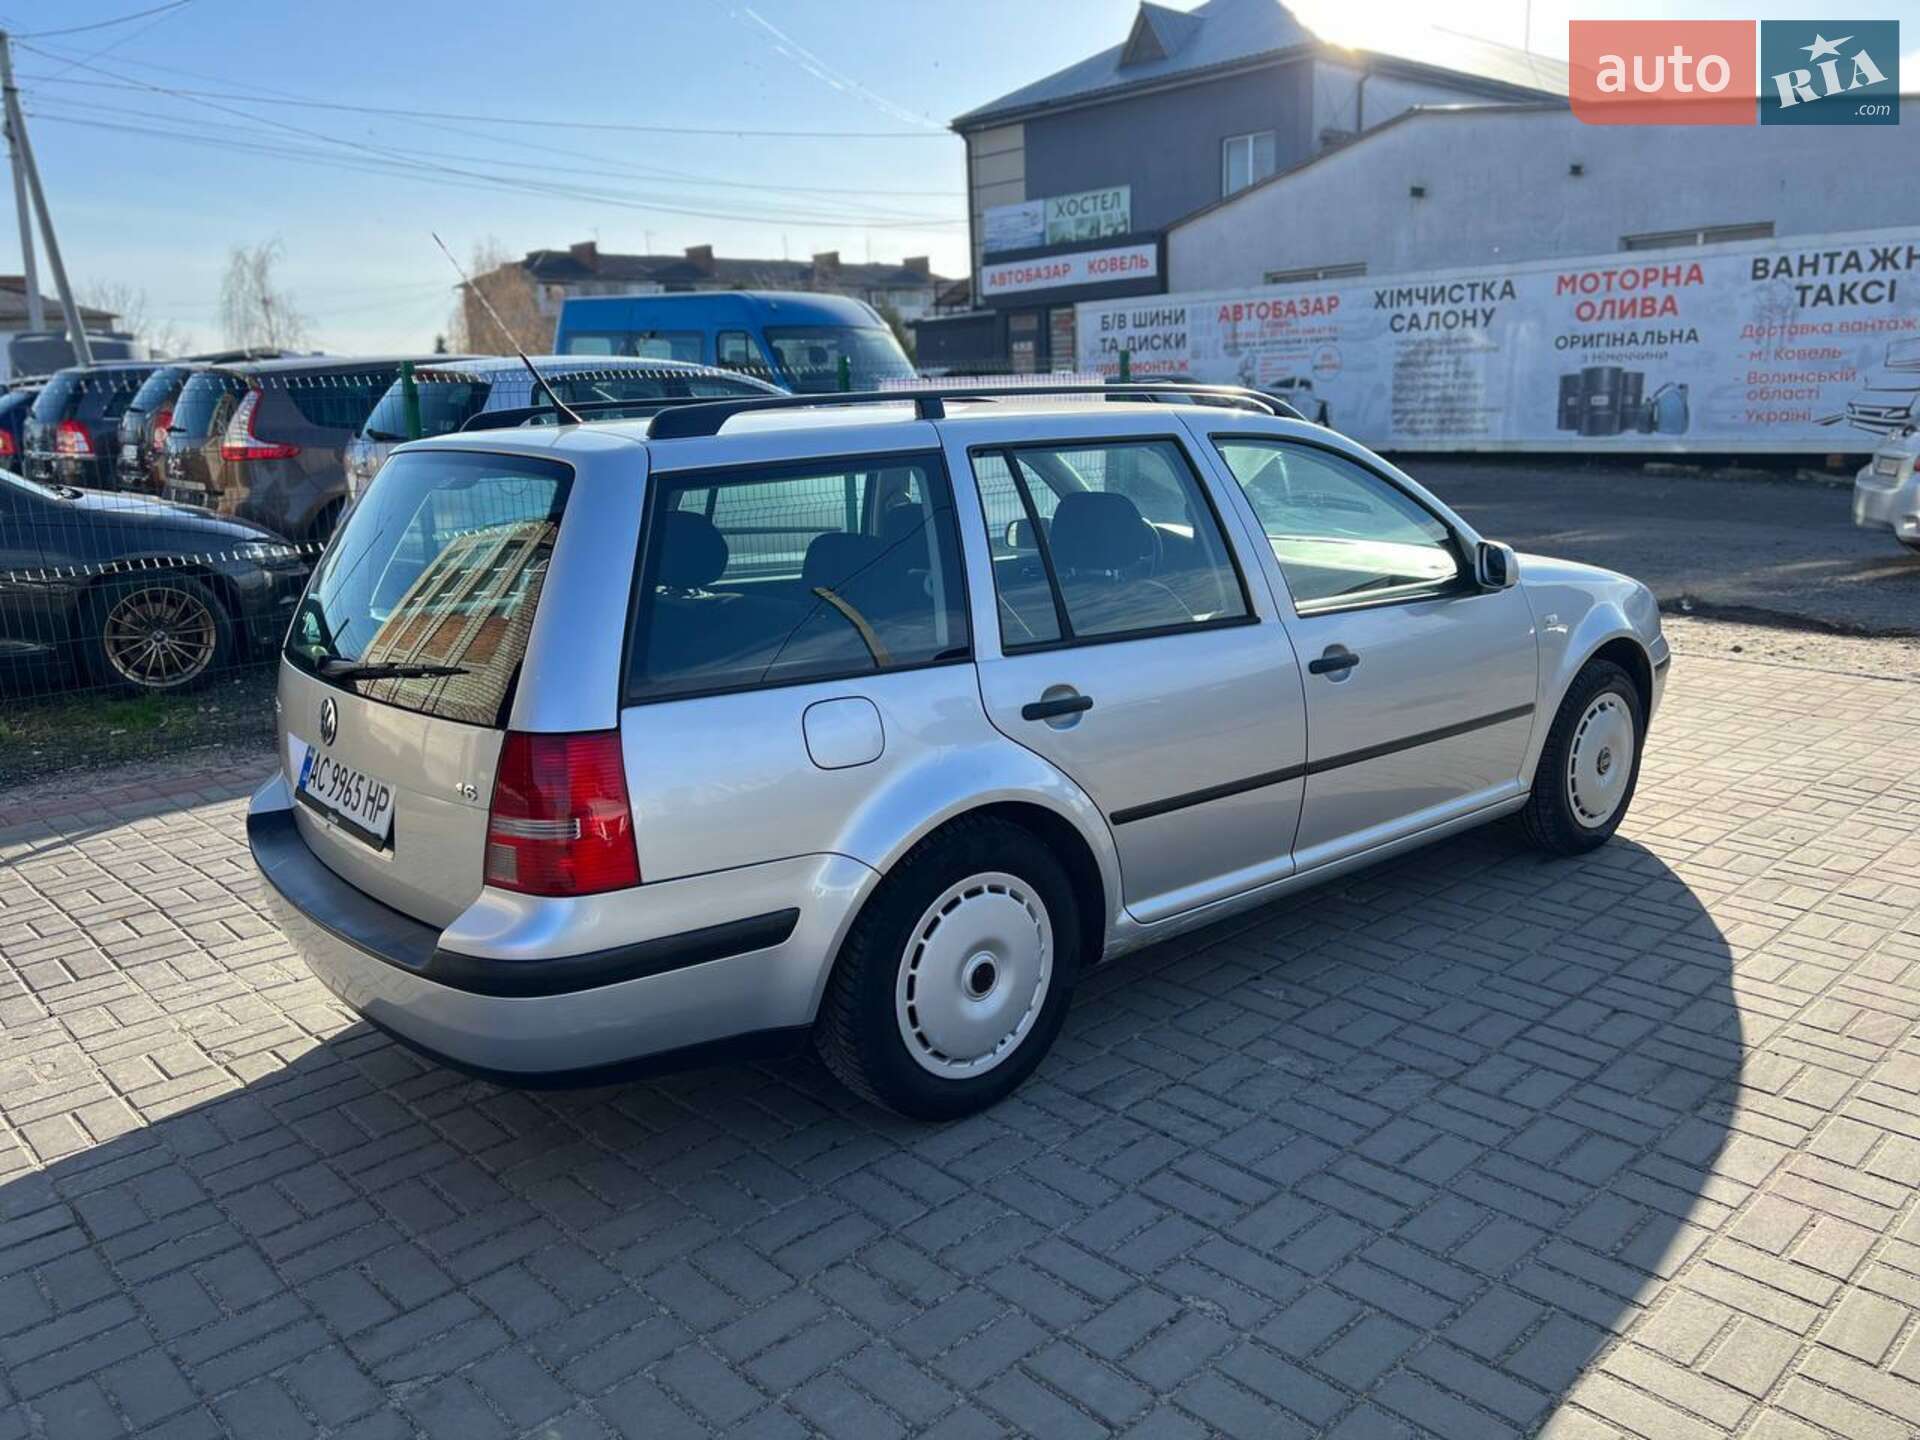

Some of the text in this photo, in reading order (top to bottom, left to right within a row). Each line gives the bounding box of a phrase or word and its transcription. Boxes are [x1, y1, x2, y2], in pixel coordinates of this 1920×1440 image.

[1056, 191, 1121, 218] ХОСТЕЛ
[989, 254, 1149, 287] АВТОБАЗАР КОВЕЛЬ
[1556, 263, 1704, 296] МОТОРНА
[1374, 279, 1516, 309] ХІМЧИСТКА
[1795, 279, 1897, 308] ТАКСІ
[1101, 308, 1186, 331] Б/В ШИНИ
[1217, 295, 1340, 323] АВТОБАЗАР
[1390, 308, 1495, 333] САЛОНУ
[1575, 294, 1679, 322] ОЛИВА
[1100, 332, 1186, 353] ТА ДИСКИ
[1554, 328, 1699, 350] ОРИГІНАЛЬНА
